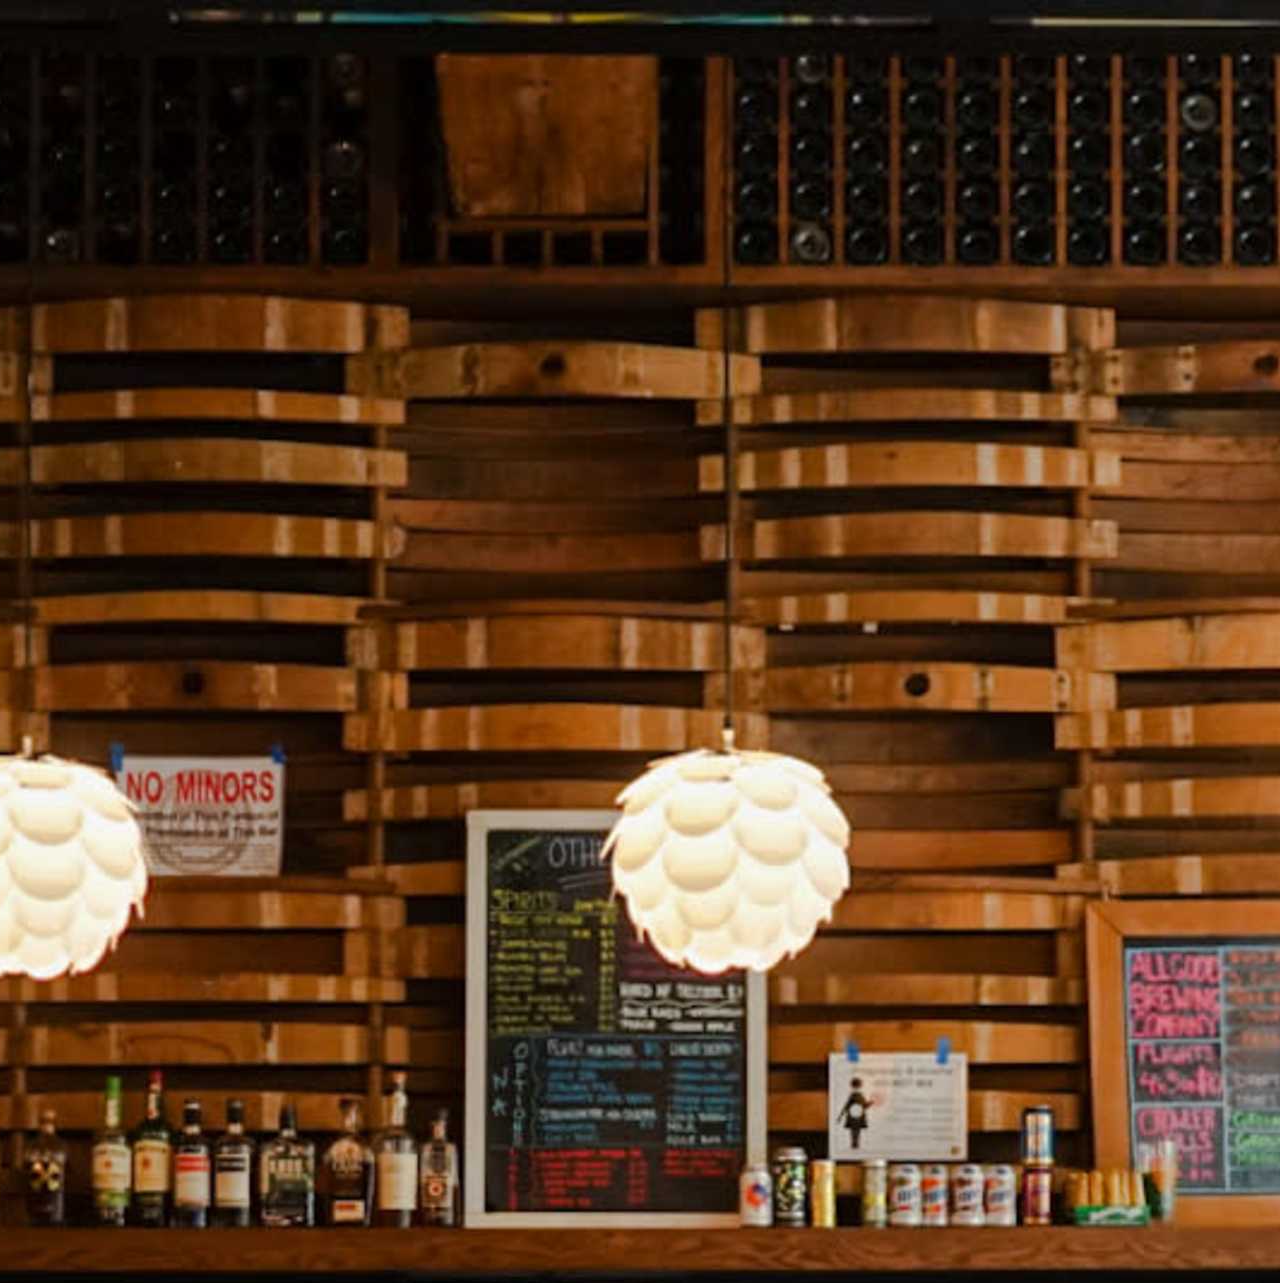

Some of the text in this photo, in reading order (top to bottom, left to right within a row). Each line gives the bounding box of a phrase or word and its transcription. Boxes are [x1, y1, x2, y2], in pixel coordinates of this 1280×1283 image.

[127, 771, 274, 804] NO MINORS
[1131, 1013, 1217, 1037] COMPANY
